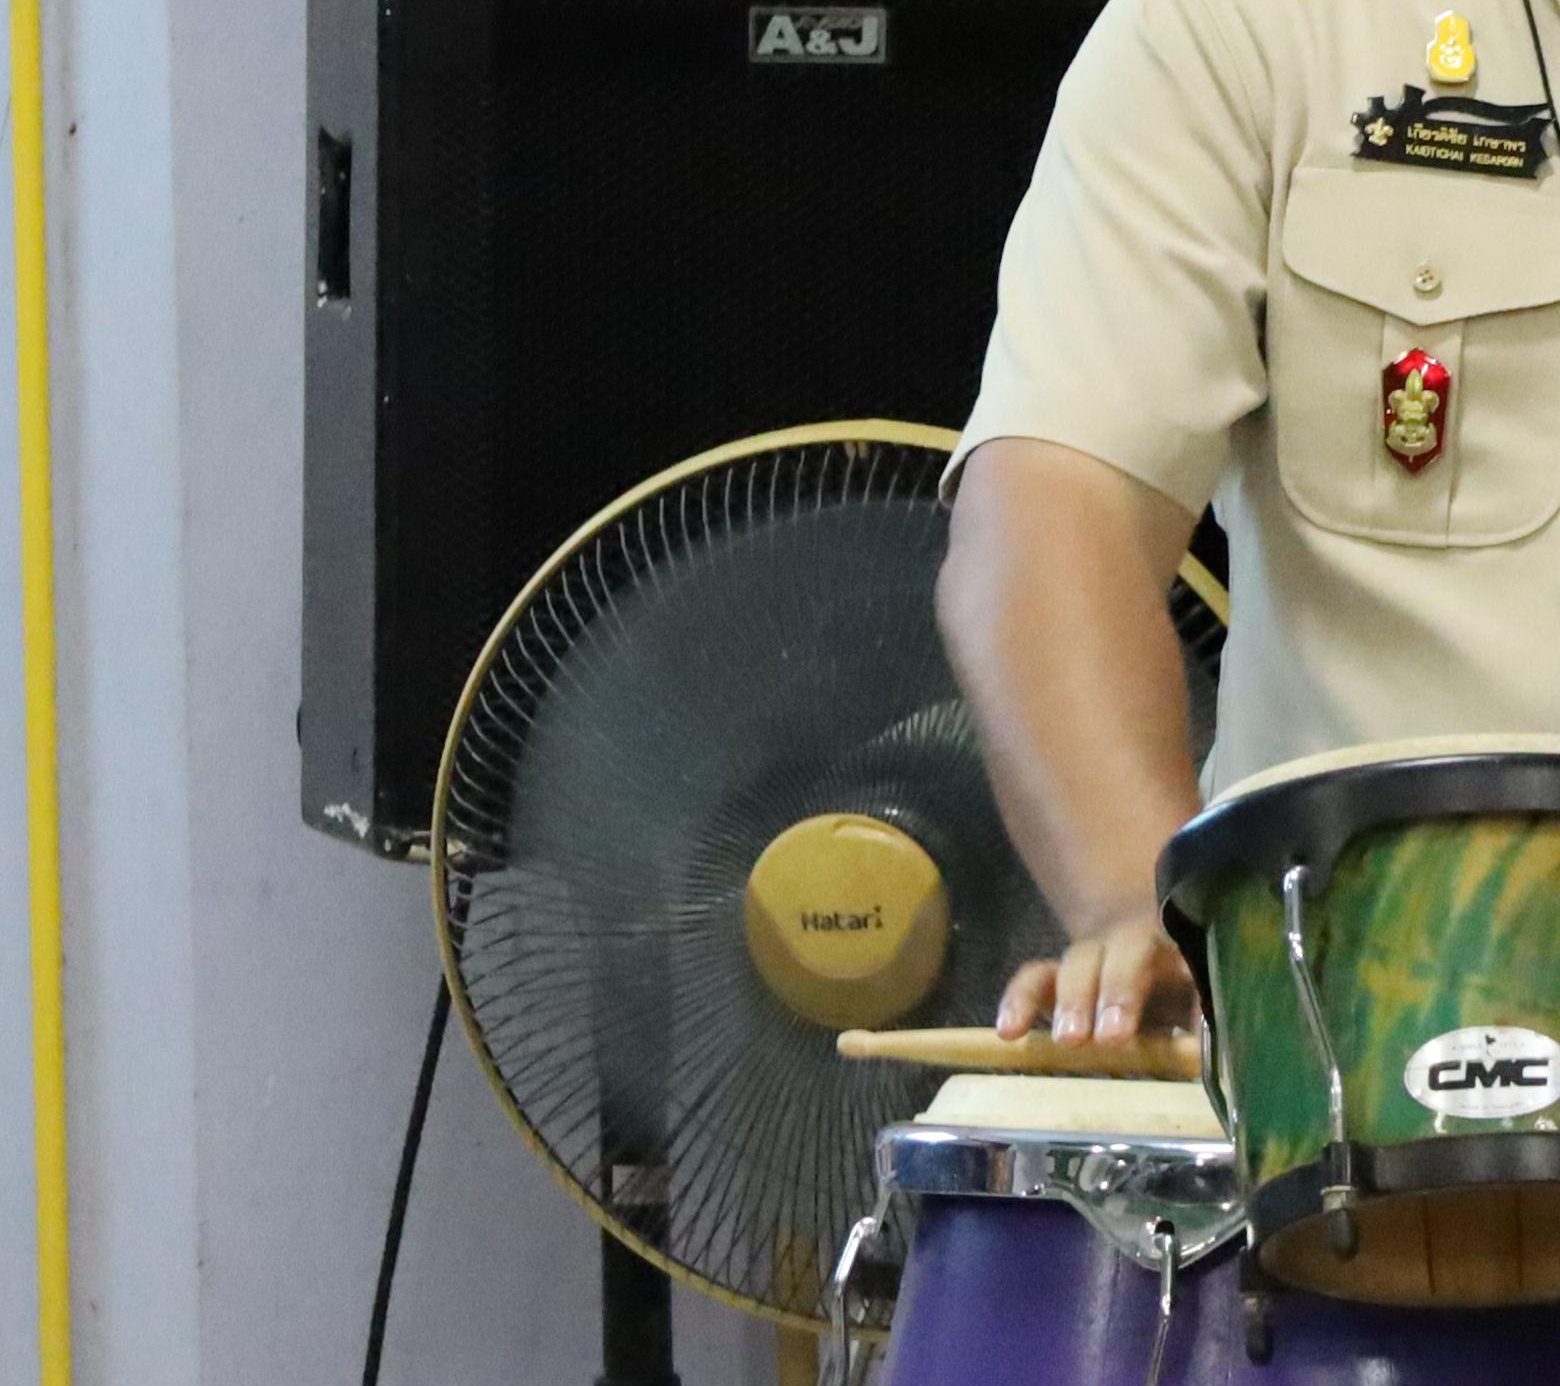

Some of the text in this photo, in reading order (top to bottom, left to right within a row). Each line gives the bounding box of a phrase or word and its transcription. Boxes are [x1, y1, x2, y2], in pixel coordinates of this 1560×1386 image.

[757, 14, 878, 55] A&J
[801, 904, 883, 931] Hatari
[1428, 1058, 1549, 1091] CMC
